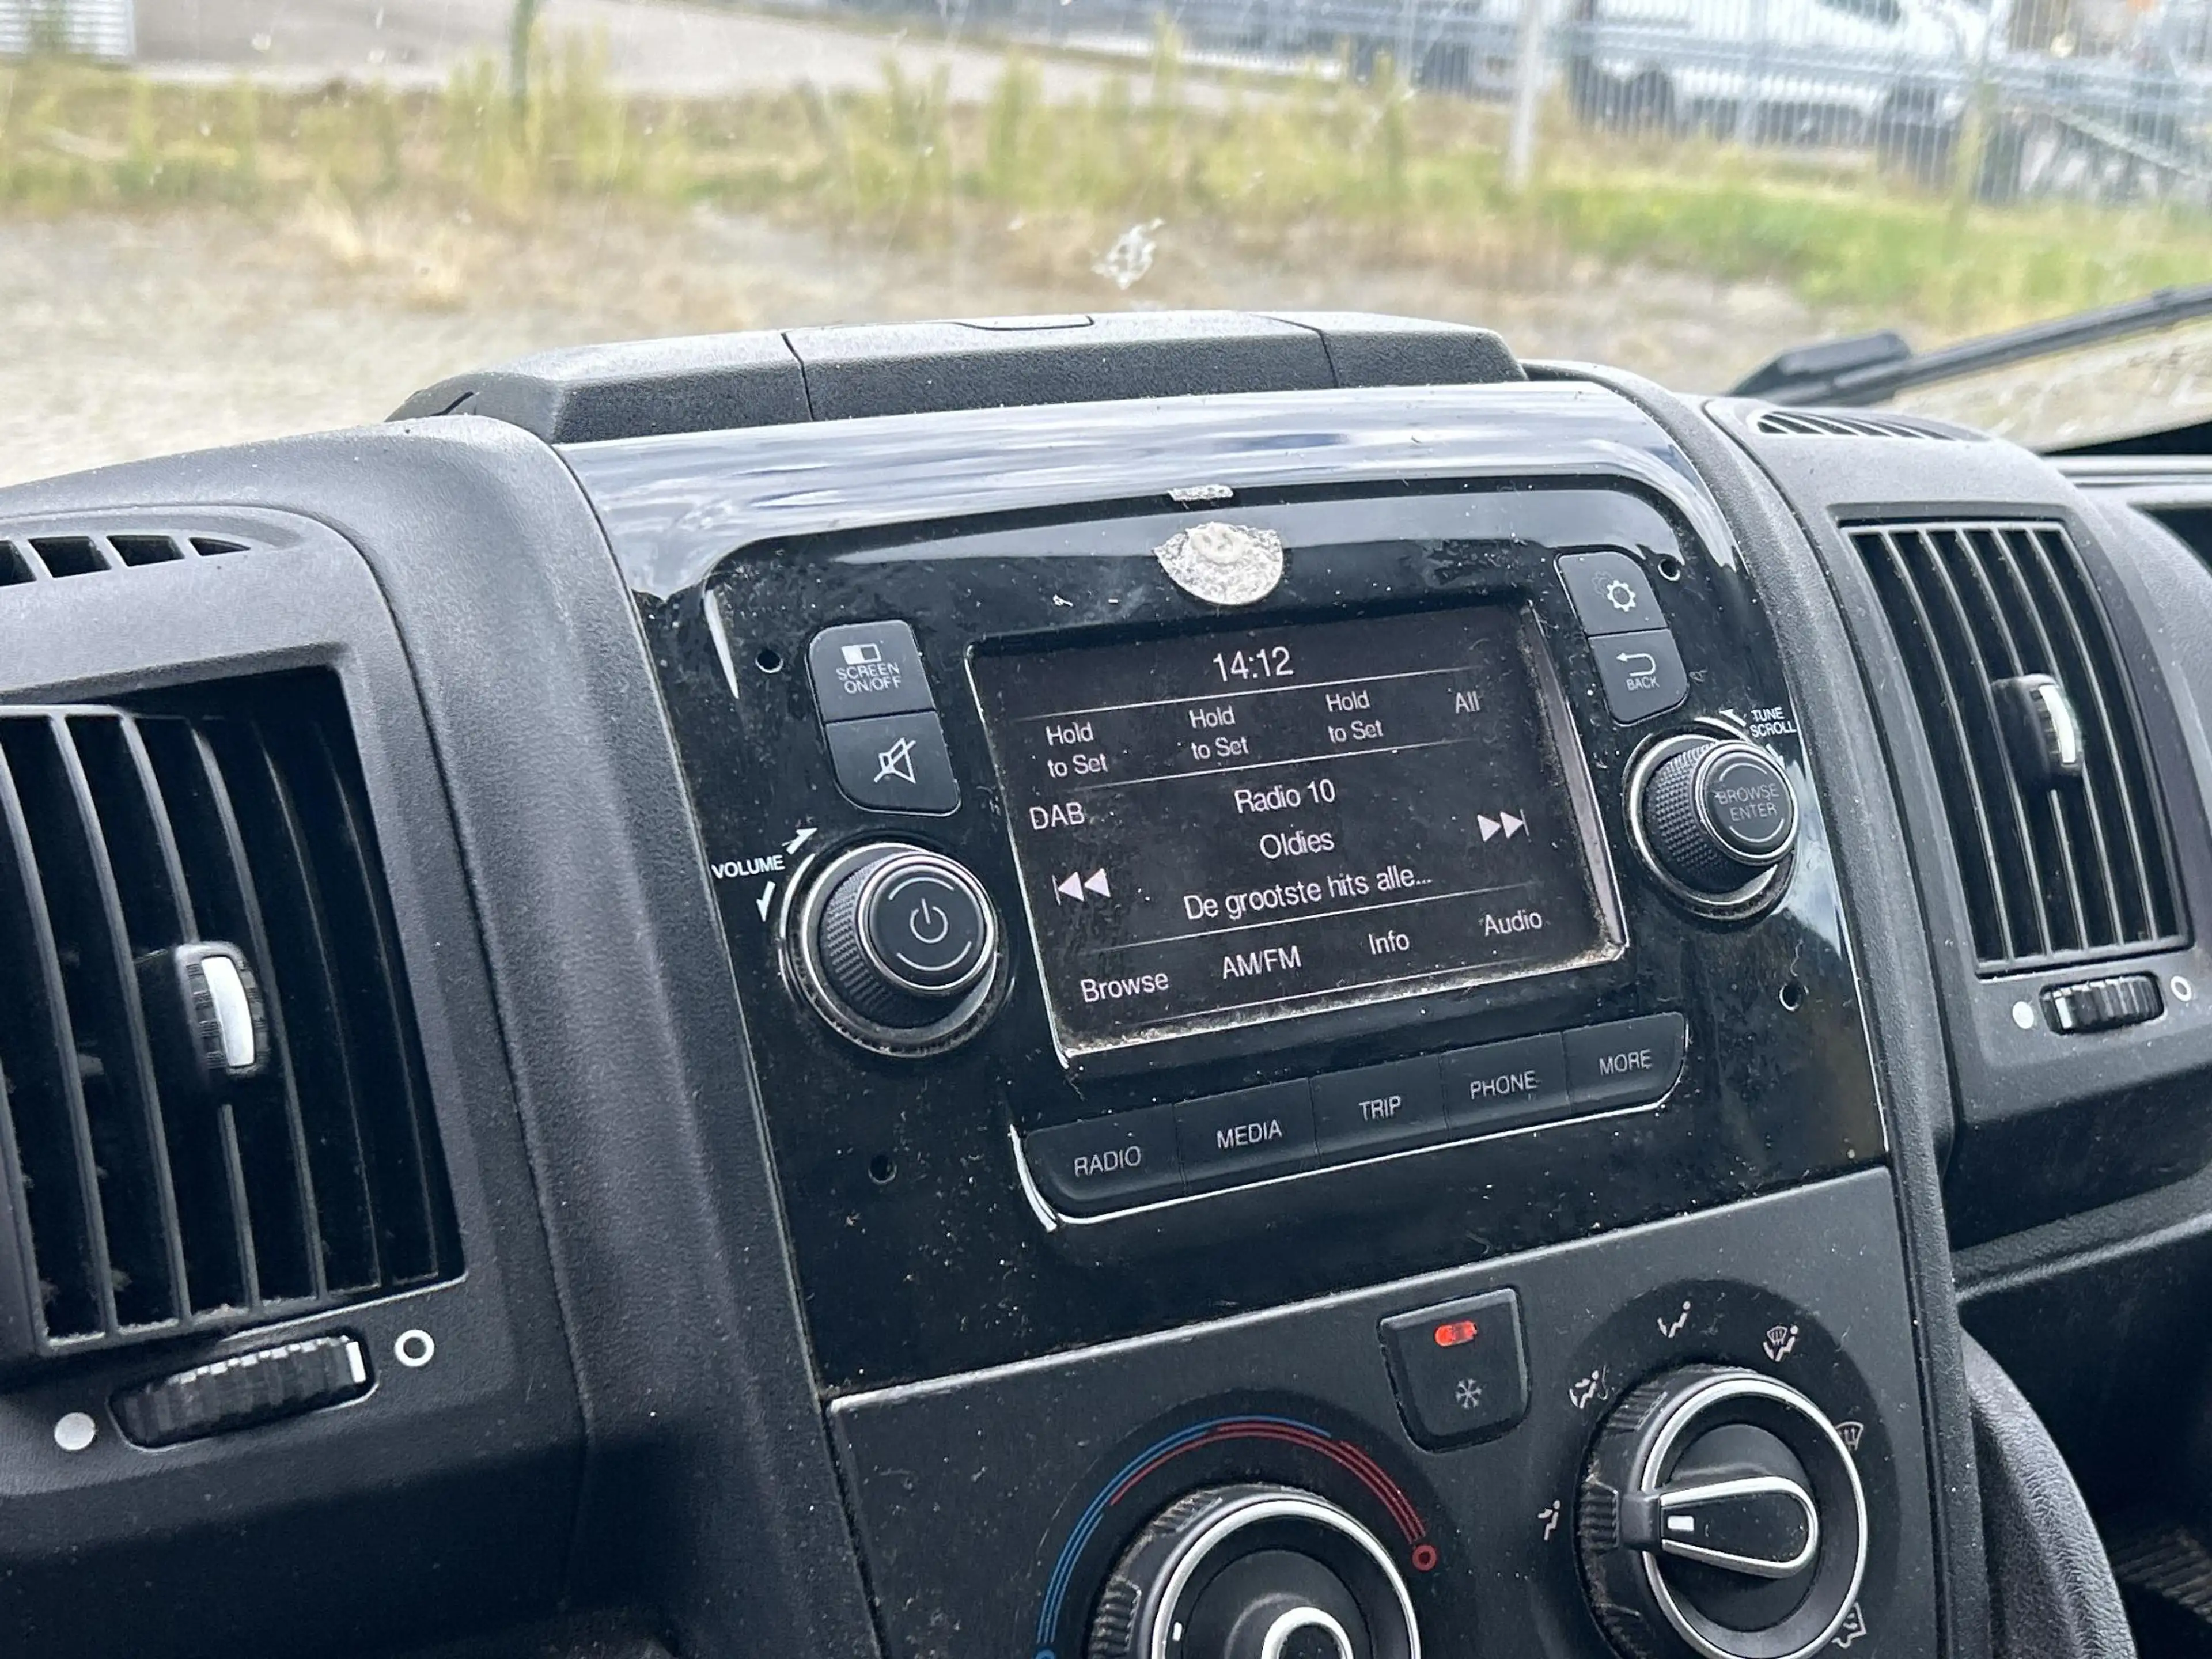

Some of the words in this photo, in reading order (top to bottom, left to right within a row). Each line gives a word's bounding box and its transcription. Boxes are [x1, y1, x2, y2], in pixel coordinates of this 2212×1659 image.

[836, 662, 900, 679] SCREEN
[1213, 647, 1294, 683] 14:12
[844, 676, 903, 694] ON/OFF
[1626, 676, 1660, 690] BACK
[1326, 691, 1370, 713] Hold
[1454, 692, 1482, 713] All
[1751, 707, 1785, 722] TUNE
[1189, 707, 1236, 730] Hold
[1328, 723, 1349, 743] to
[1352, 719, 1384, 740] Set
[1750, 719, 1797, 738] SCROLL
[1046, 722, 1094, 745] Hold
[1191, 740, 1212, 760] to
[1215, 736, 1249, 757] Set
[1048, 758, 1069, 778] to
[1073, 753, 1108, 776] Set
[1234, 782, 1301, 813] Radio
[1307, 779, 1336, 805] 10
[1717, 783, 1780, 806] BROWSE
[1029, 802, 1085, 830] DAB
[1730, 802, 1778, 823] ENTER
[1259, 830, 1335, 860] Oldies
[711, 854, 786, 880] VOLUME
[1183, 893, 1219, 921] De
[1225, 877, 1322, 918] grootste
[1327, 871, 1369, 899] hits
[1483, 909, 1543, 937] Audio
[1369, 930, 1410, 956] Info
[1222, 945, 1302, 979] AM/FM
[1081, 970, 1169, 1003] Browse
[1598, 1049, 1653, 1077] MORE
[1469, 1070, 1537, 1099] PHONE
[1358, 1094, 1402, 1123] TRIP
[1215, 1120, 1283, 1149] MEDIA
[1073, 1146, 1142, 1177] RADIO
